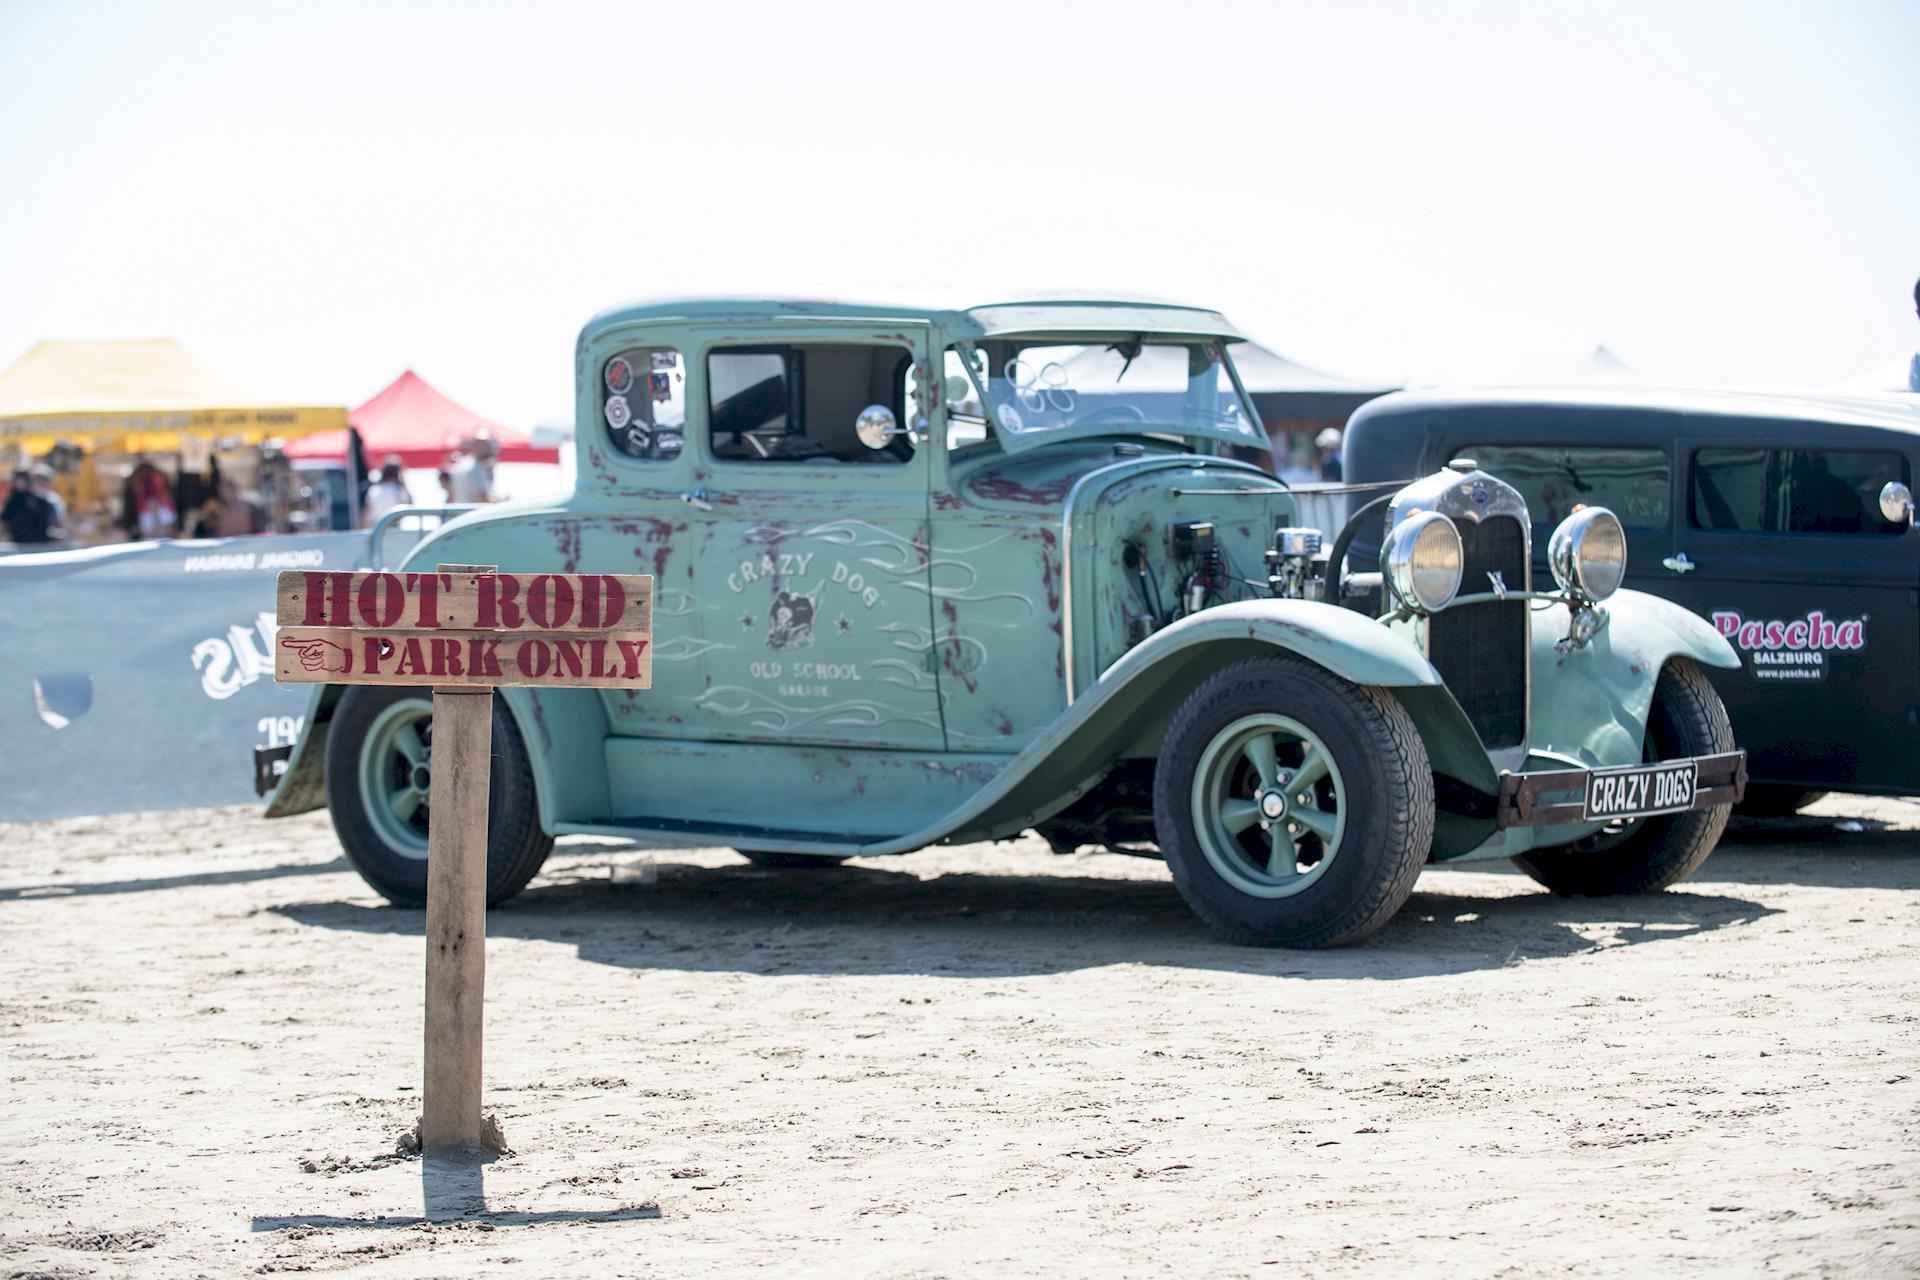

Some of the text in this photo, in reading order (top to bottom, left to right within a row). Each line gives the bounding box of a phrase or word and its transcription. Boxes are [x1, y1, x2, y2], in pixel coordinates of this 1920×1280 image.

[727, 552, 814, 593] CRAZY
[302, 572, 627, 629] HOT ROD
[1711, 610, 1864, 650] Pascha
[363, 637, 649, 679] PARK ONLY
[750, 661, 862, 681] OLD SCHOOL
[1753, 652, 1823, 665] SALZBURG
[1756, 668, 1821, 680] www.pascha.at
[1591, 768, 1693, 813] CRAZY DOGS
